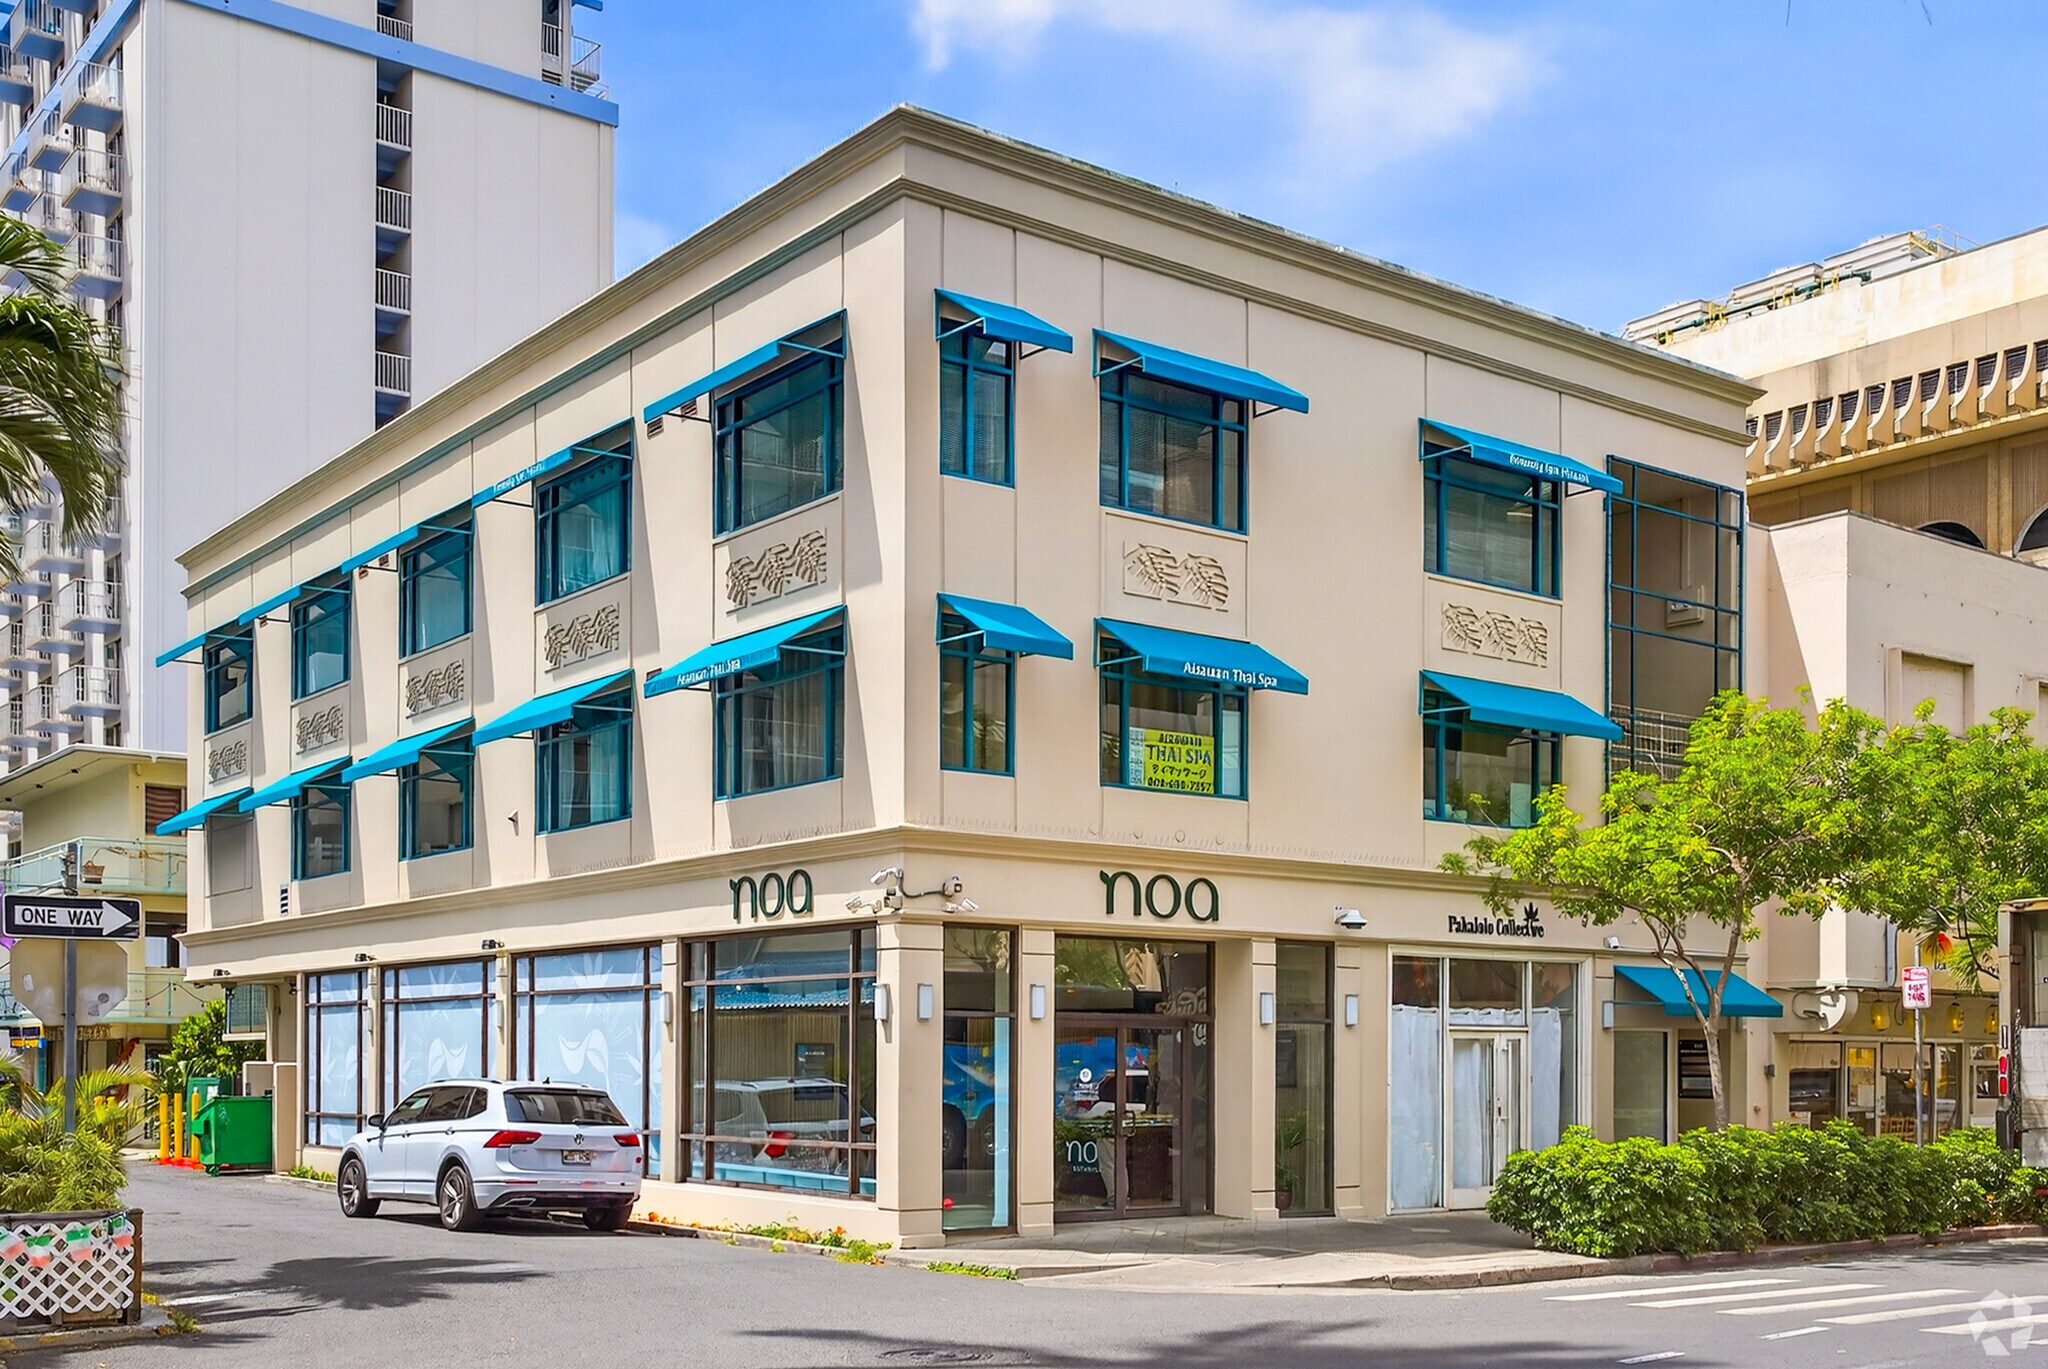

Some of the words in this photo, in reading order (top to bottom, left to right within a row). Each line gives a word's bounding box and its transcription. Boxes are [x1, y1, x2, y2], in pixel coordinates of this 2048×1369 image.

[1232, 668, 1256, 685] Thai
[1258, 672, 1278, 687] Spa
[1145, 744, 1182, 763] THAI
[1185, 748, 1212, 767] SPA
[729, 869, 812, 919] noa
[1100, 870, 1219, 922] noa
[21, 907, 57, 924] ONE
[68, 909, 103, 926] WAY
[1448, 915, 1494, 936] Pakalolo
